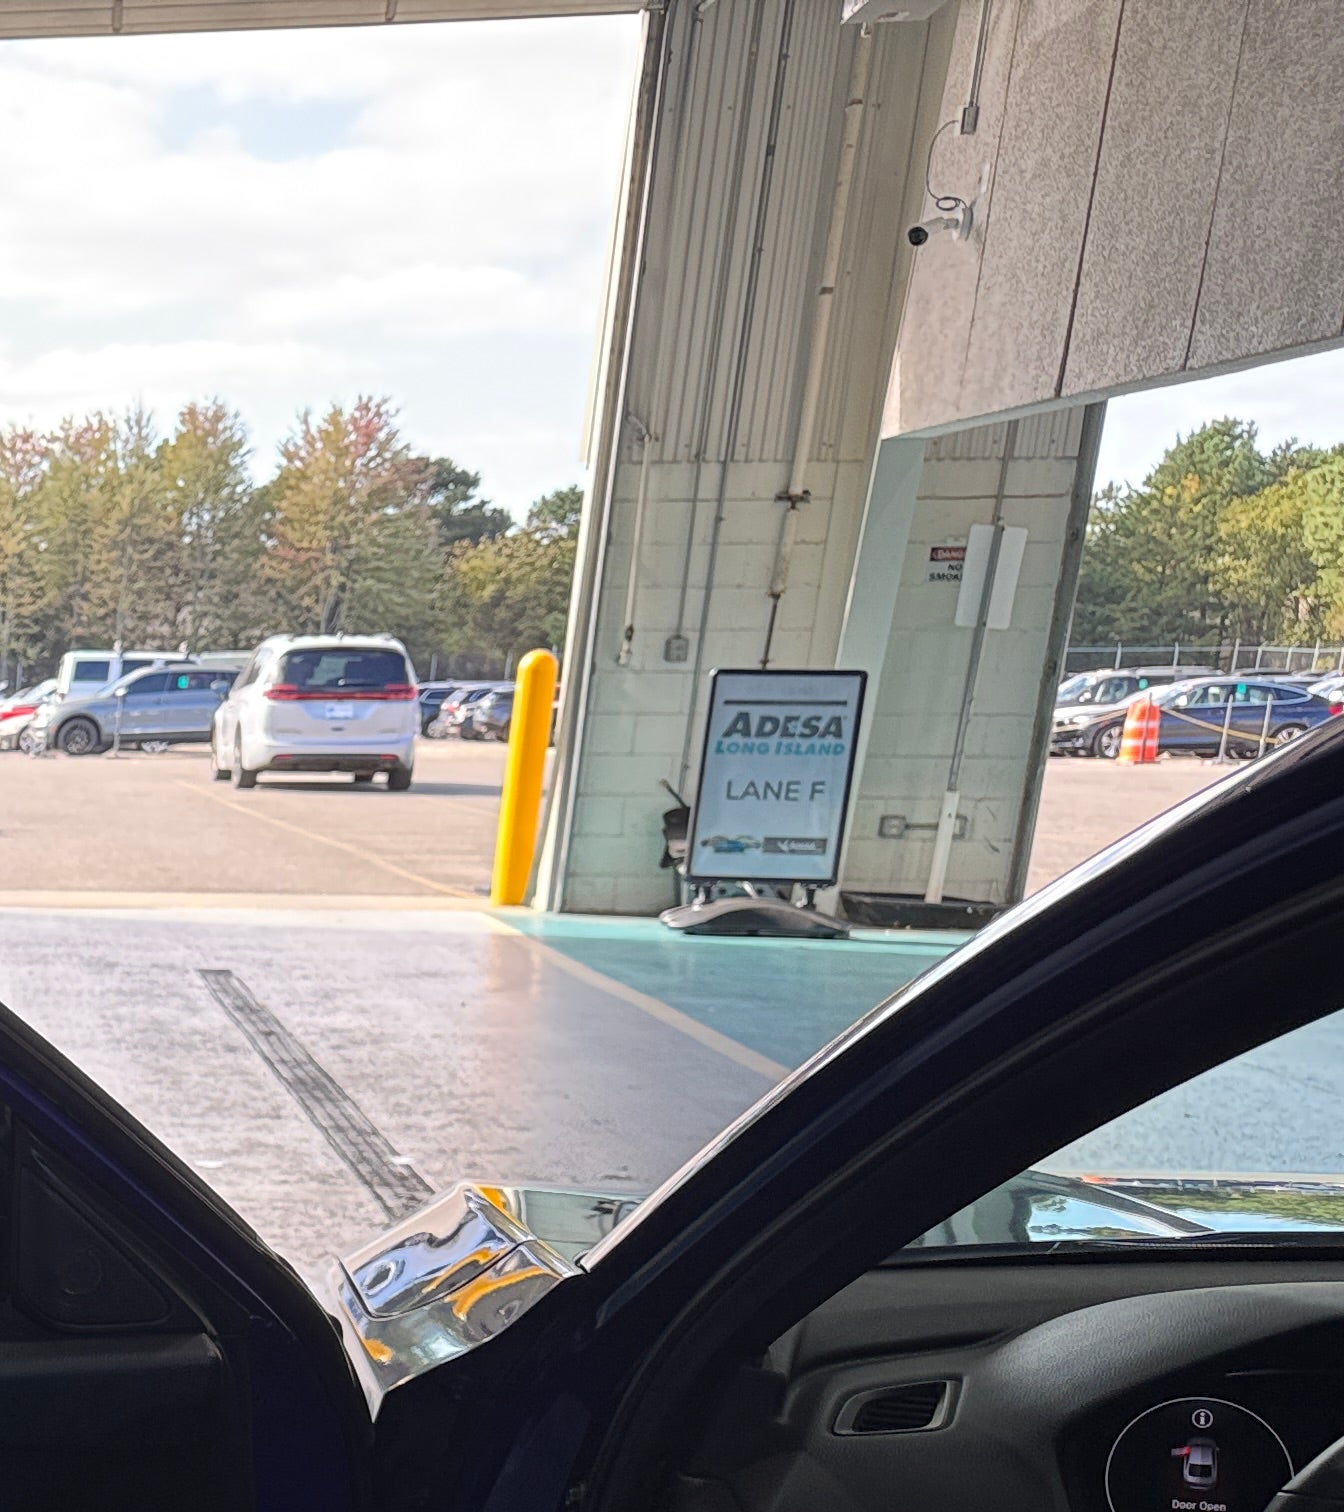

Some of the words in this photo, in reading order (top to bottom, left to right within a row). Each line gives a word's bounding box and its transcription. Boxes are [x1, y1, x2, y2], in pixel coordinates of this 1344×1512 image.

[721, 711, 844, 739] ADESA
[715, 740, 768, 755] LONG
[775, 742, 845, 756] ISLAND
[726, 779, 801, 801] LANE
[809, 780, 826, 802] F
[1172, 1499, 1196, 1510] Door
[1199, 1501, 1227, 1512] Open
